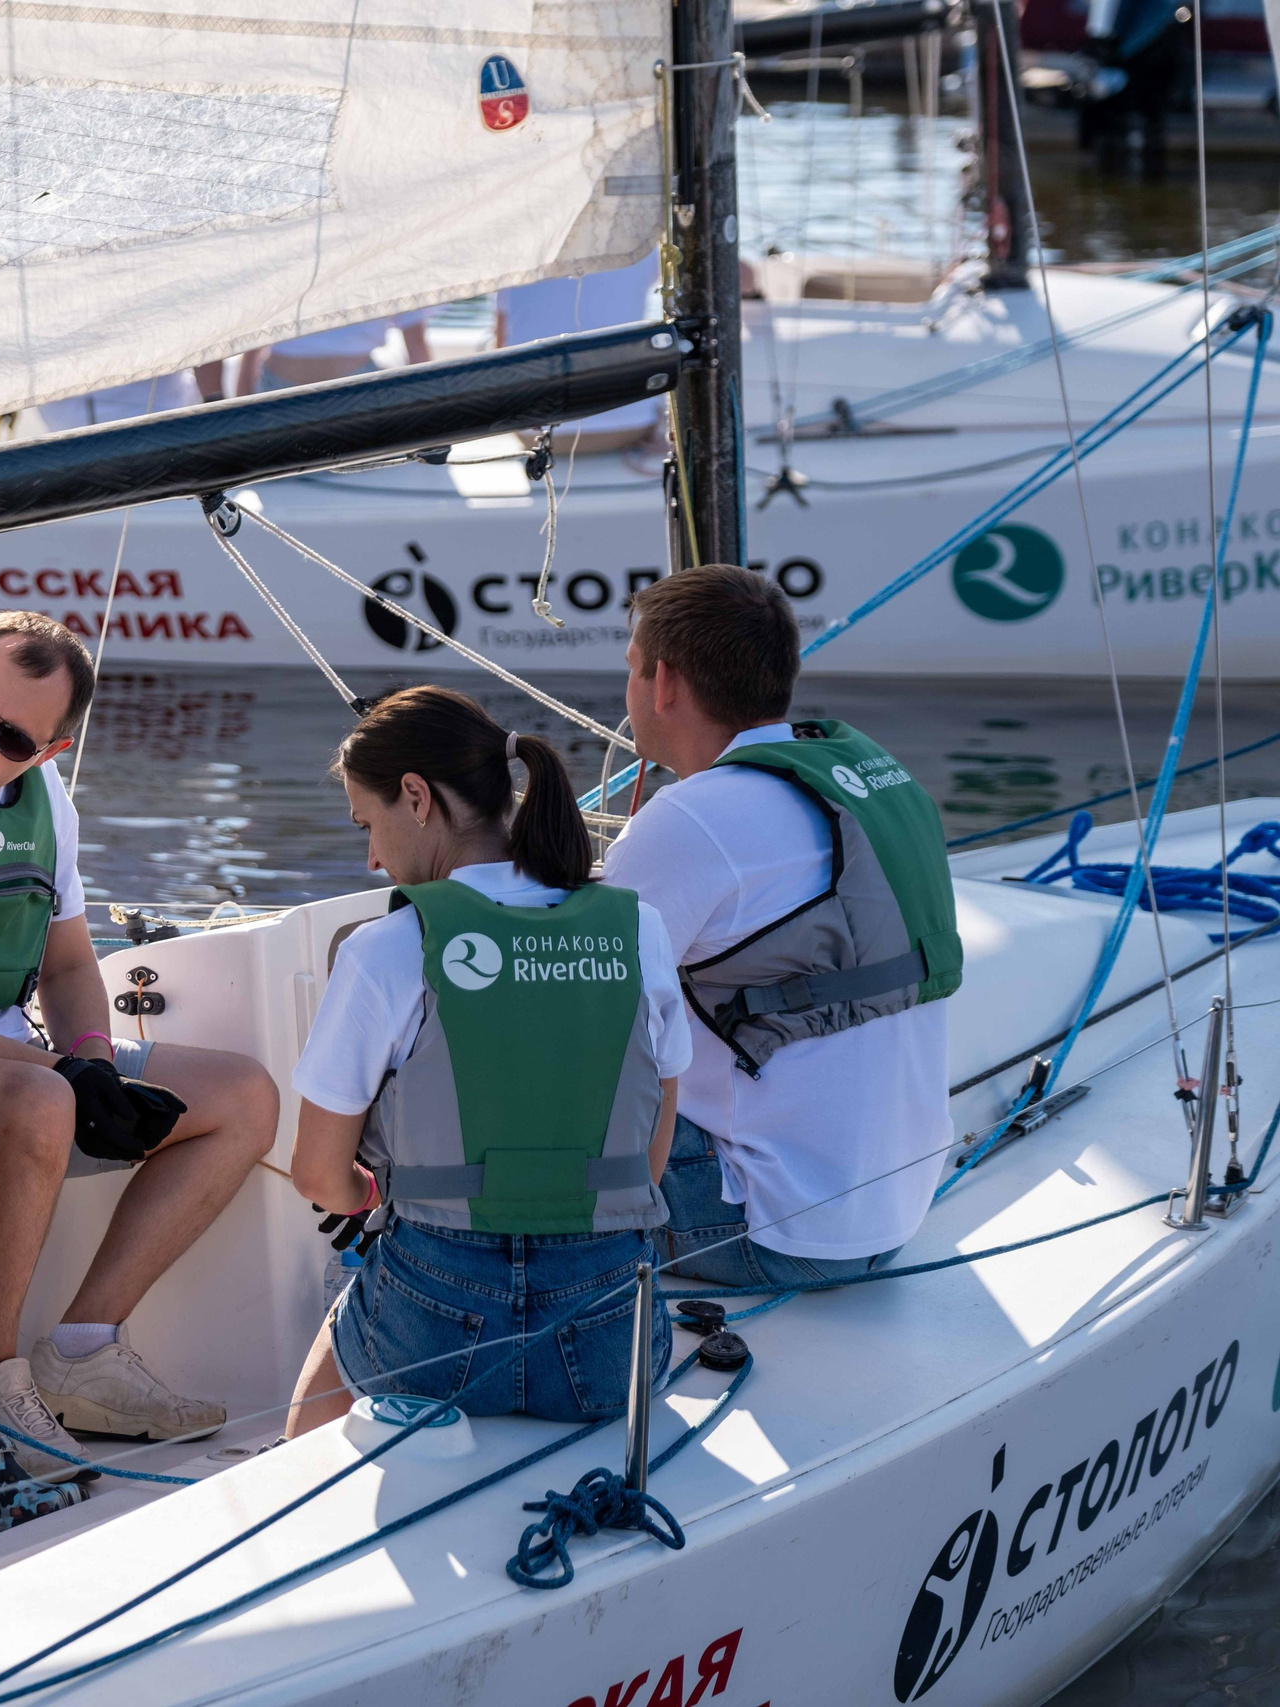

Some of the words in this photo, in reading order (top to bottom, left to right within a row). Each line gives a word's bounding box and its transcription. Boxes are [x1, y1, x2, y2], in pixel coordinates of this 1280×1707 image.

[488, 60, 510, 89] U
[493, 100, 514, 127] S
[866, 767, 912, 791] RiverClub
[6, 841, 36, 851] RiverClub
[512, 935, 625, 952] КОНАКОВО
[513, 957, 628, 982] RiverClub
[1006, 1339, 1240, 1578] СТОЛОТО
[979, 1511, 1148, 1651] Государственные
[1144, 1454, 1211, 1532] лотереи
